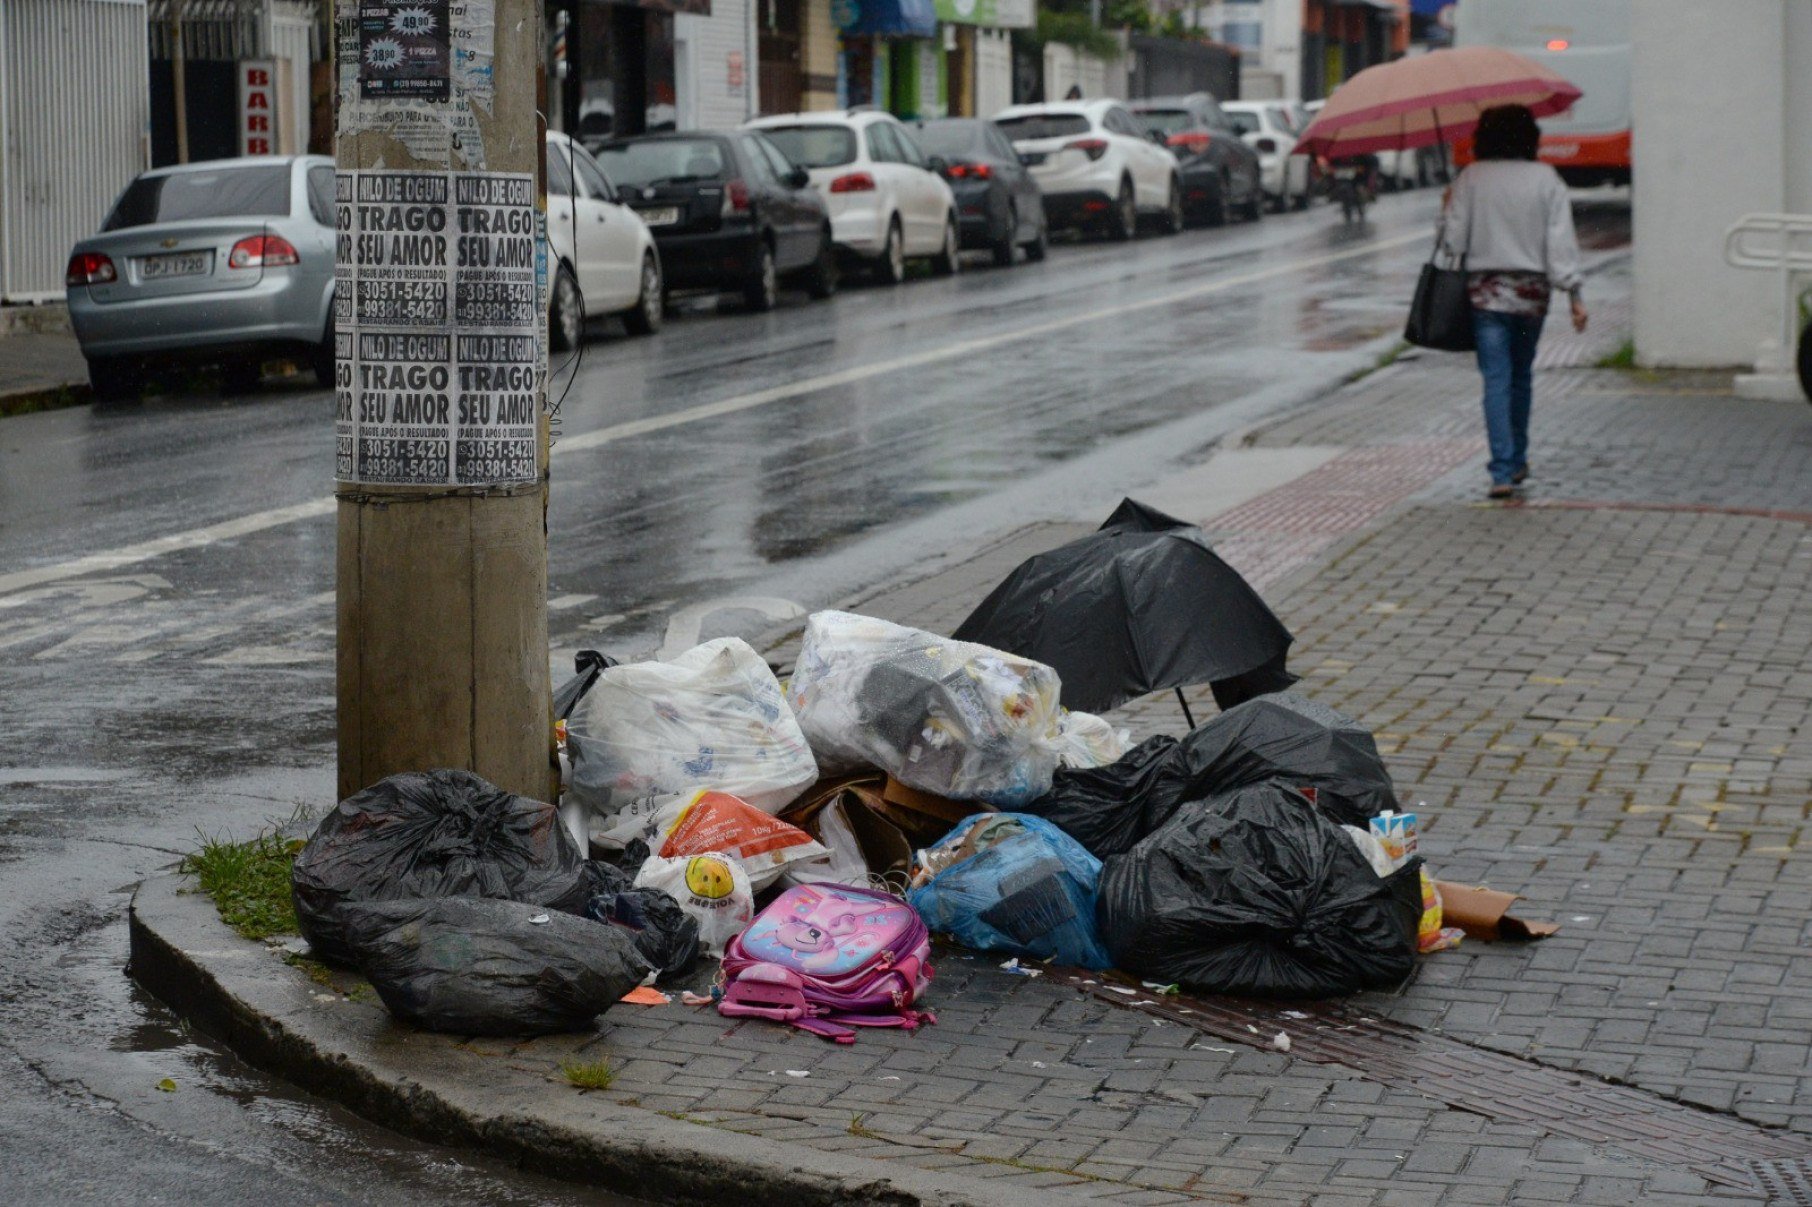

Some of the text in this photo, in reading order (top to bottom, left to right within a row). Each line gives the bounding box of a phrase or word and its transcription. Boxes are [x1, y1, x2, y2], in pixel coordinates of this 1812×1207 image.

[360, 177, 383, 199] NILO
[386, 178, 401, 199] DE
[406, 178, 445, 200] OGUM
[458, 179, 531, 205] NILO DE OGUM
[357, 206, 446, 232] TRAGO
[457, 208, 532, 235] TRAGO
[357, 235, 446, 266] SEU AMOR
[457, 237, 532, 268] SEU AMOR
[365, 283, 445, 300] 3051-5420
[467, 285, 532, 300] 3051-5420
[365, 301, 445, 317] 99381-5420
[466, 303, 532, 320] 99381-5420
[362, 336, 385, 358] NILO
[388, 337, 404, 359] DE
[408, 337, 448, 360] OGUM
[459, 337, 533, 362] NILO DE OGUM
[360, 365, 449, 391] TRAGO
[458, 366, 533, 391] TRAGO
[360, 392, 449, 424] SEU AMOR
[459, 394, 534, 425] SEU AMOR
[366, 441, 447, 458] 3051-5420
[467, 441, 533, 458] 3051-5420
[366, 459, 446, 477] 99381-5420
[466, 460, 533, 477] 99381-5420
